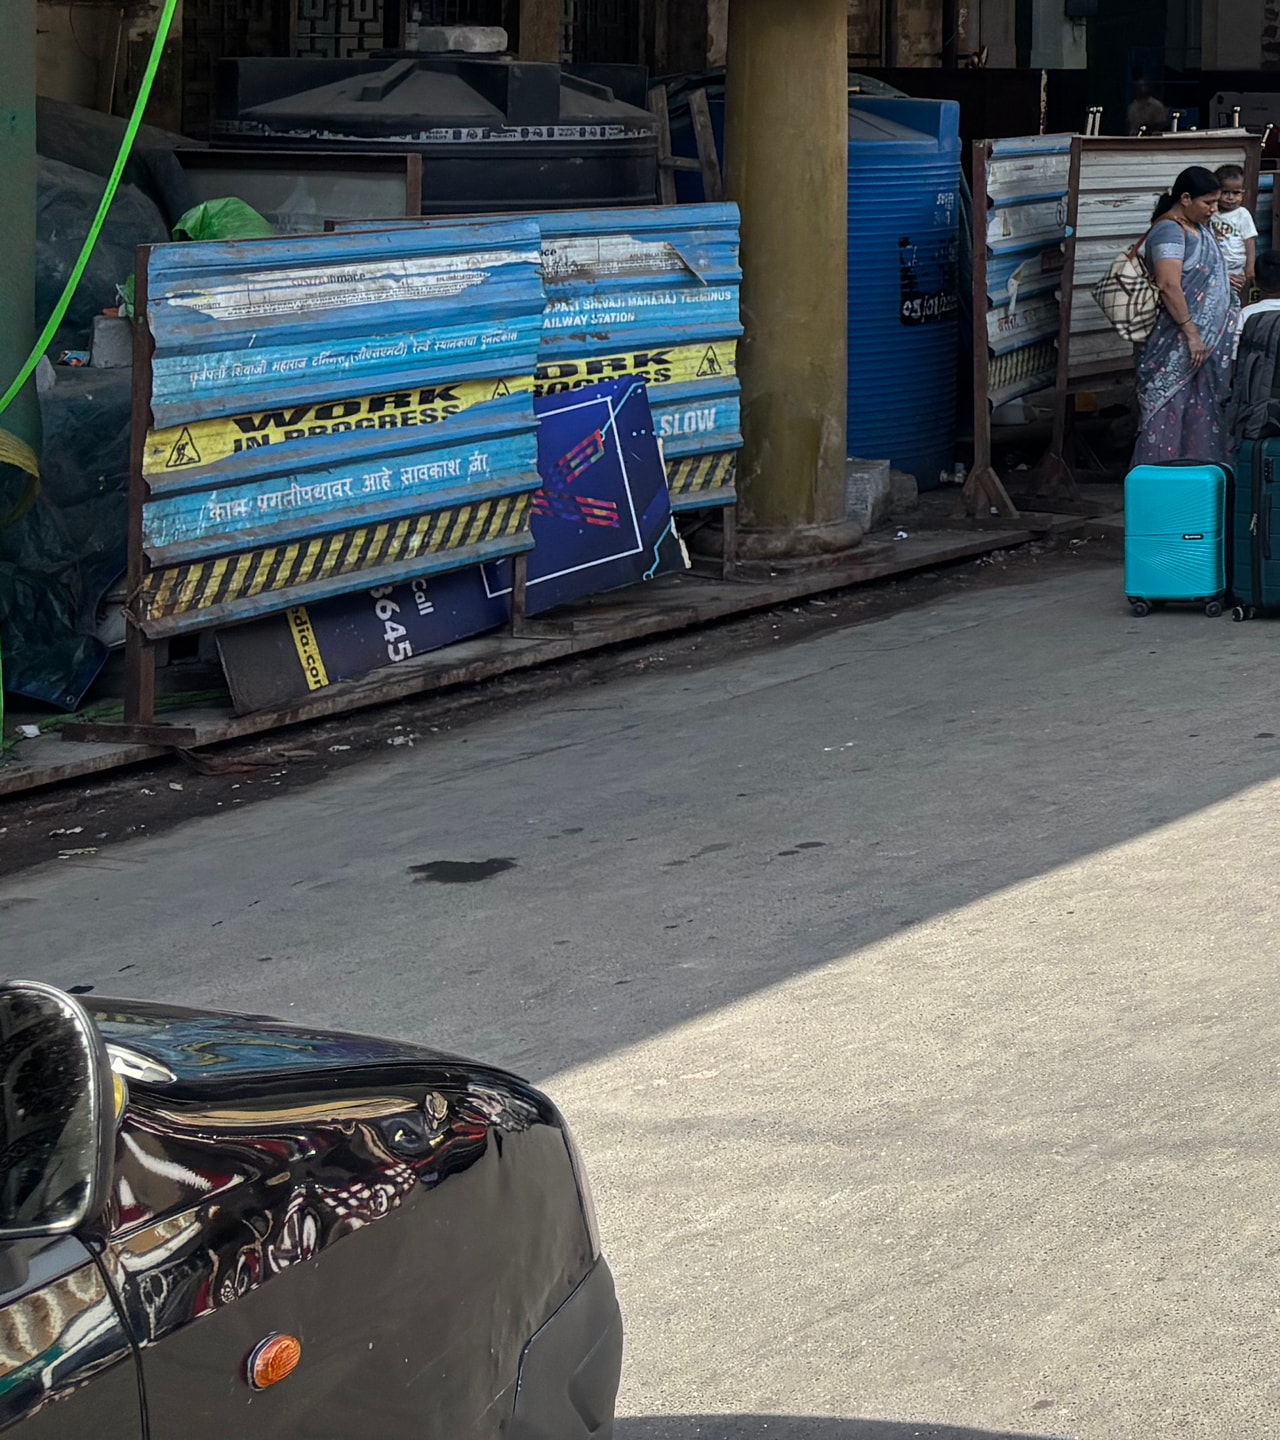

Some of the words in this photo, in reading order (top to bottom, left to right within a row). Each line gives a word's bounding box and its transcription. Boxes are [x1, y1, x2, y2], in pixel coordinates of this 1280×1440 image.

[628, 294, 676, 308] MAHARAJ
[681, 290, 732, 304] TERMINUS
[591, 312, 635, 325] STATION
[272, 357, 307, 372] महाराज
[534, 349, 676, 380] ORK
[232, 384, 463, 434] WORK
[660, 407, 716, 436] SLOW
[362, 467, 392, 491] आहे
[400, 460, 461, 484] सावकाश
[412, 579, 434, 615] Call
